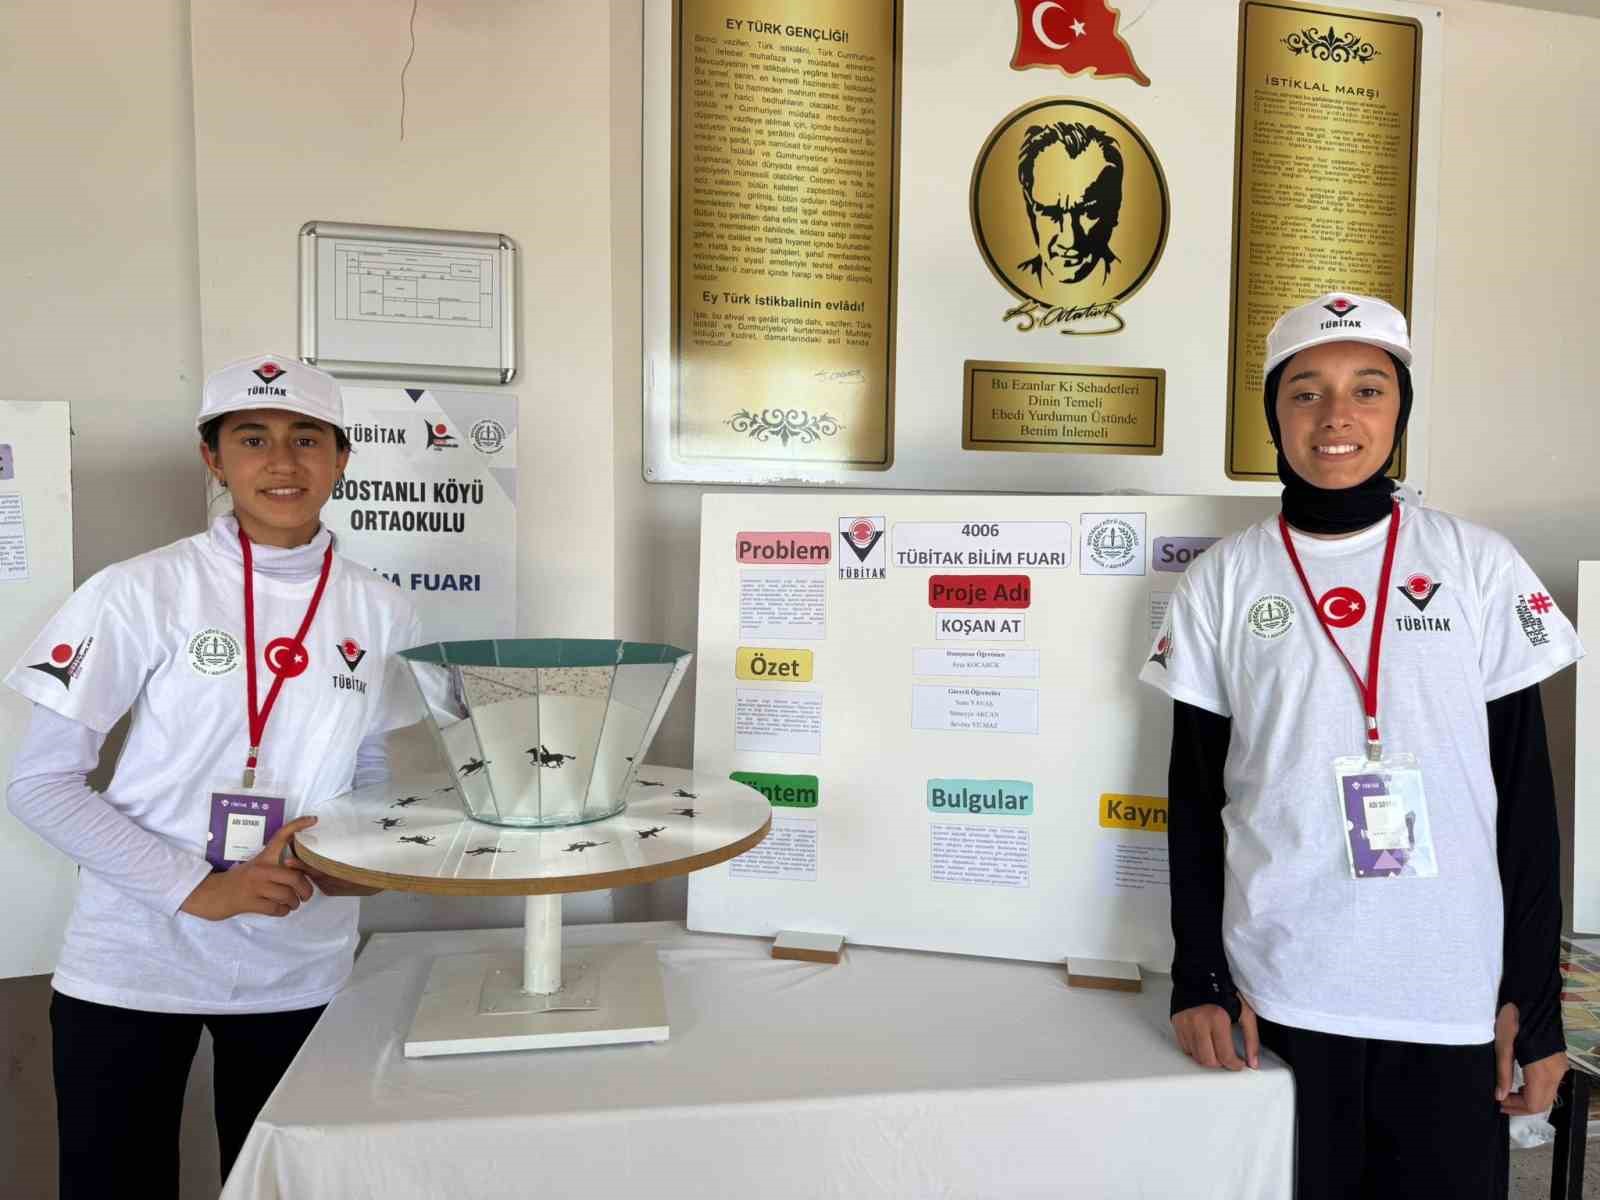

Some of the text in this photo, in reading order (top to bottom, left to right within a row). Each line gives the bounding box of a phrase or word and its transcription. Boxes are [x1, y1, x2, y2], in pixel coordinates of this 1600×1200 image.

[726, 19, 848, 43] EY TÜRK GENÇLİĞİ!
[1266, 73, 1379, 100] İSTİKLAL MARŞI
[702, 290, 717, 304] Ey
[723, 291, 750, 305] Türk
[754, 293, 820, 309] istikbalinin
[1320, 319, 1362, 330] TÜBİTAK
[247, 385, 287, 397] TÜBİTAK
[992, 378, 1008, 390] Bu
[1012, 380, 1056, 392] Ezanlar
[1059, 381, 1073, 393] Ki
[1029, 395, 1102, 409] Dinin Temeli
[992, 408, 1137, 425] Ebedi Yurdumun Üstünde
[345, 423, 406, 444] TÜBİTAK
[1021, 425, 1108, 438] Benim İnlemeli
[332, 478, 484, 504] BOSTANLI KÖYÜ
[351, 510, 465, 533] ORTAOKULU
[961, 523, 1000, 537] 4006
[739, 540, 830, 560] Problem
[897, 549, 1065, 566] TÜBİTAK BİLİM FUARI
[411, 573, 481, 592] FUARI
[840, 567, 886, 580] TÜBİTAK
[933, 583, 1029, 606] Proje Adı
[942, 619, 1021, 636] KOŞAN AT
[1396, 617, 1451, 632] TÜBİTAK
[750, 652, 800, 677] Özet
[333, 674, 367, 694] TÜBİTAK
[932, 788, 1029, 814] Bulgular
